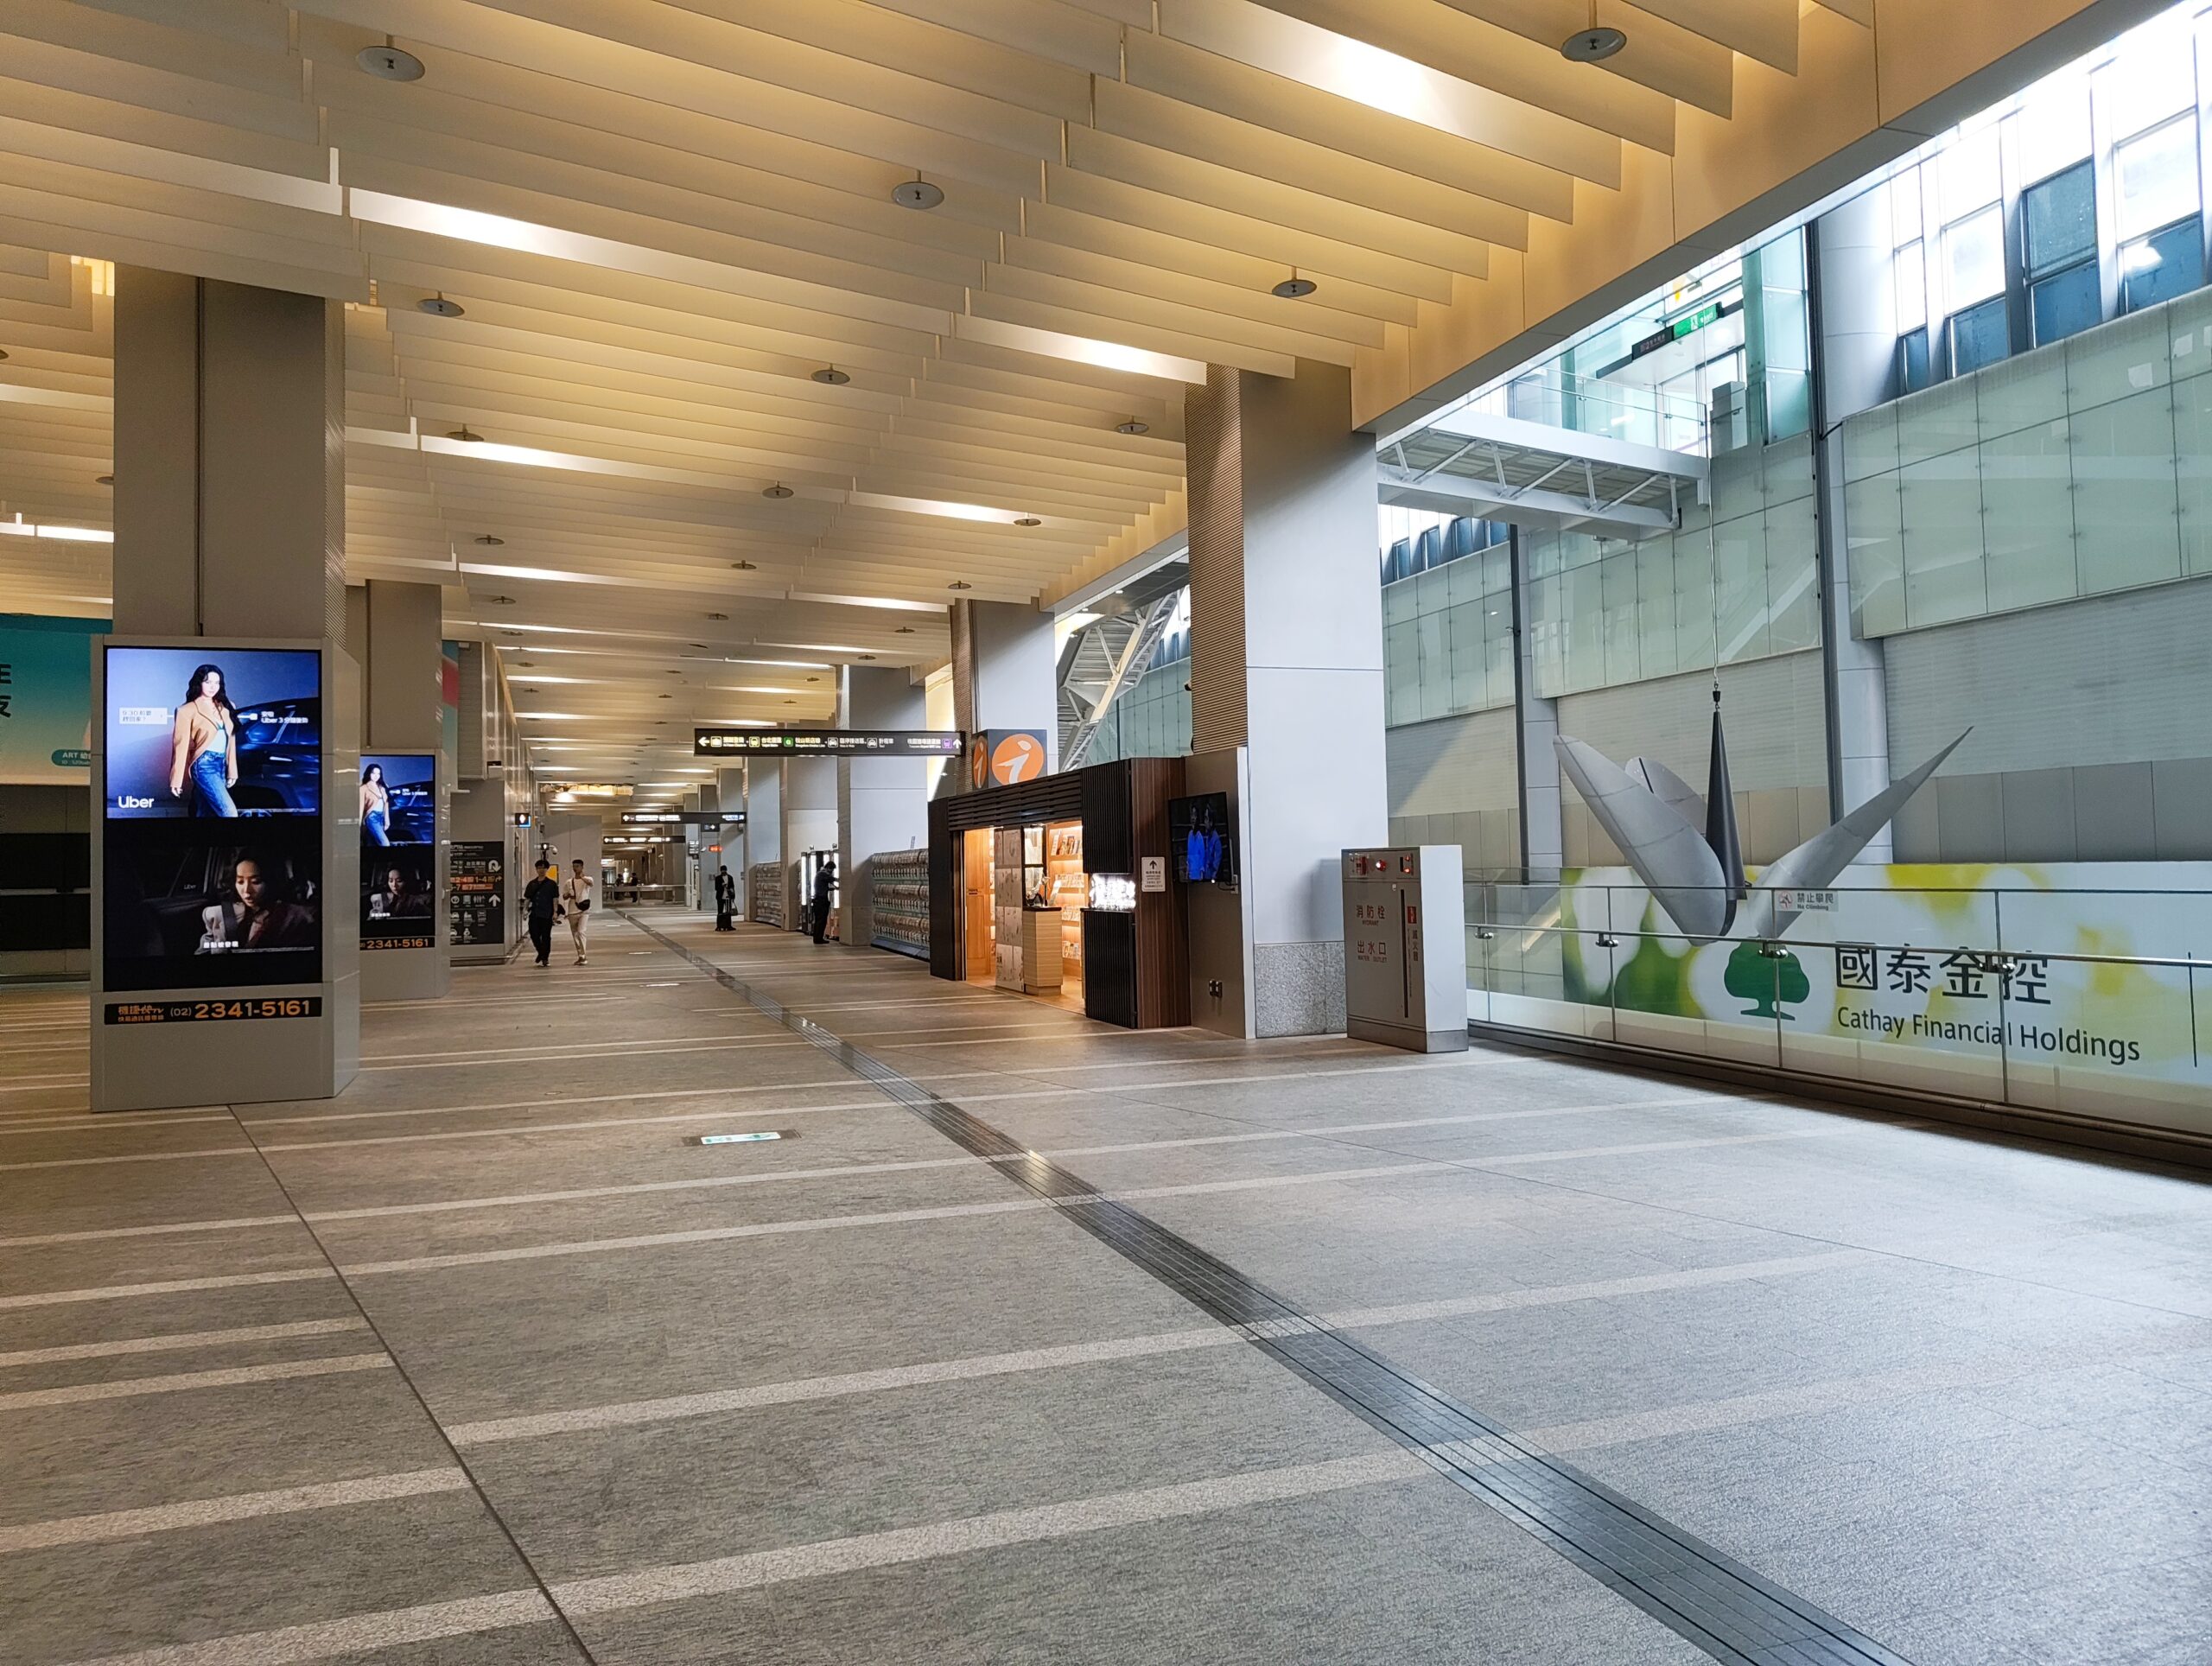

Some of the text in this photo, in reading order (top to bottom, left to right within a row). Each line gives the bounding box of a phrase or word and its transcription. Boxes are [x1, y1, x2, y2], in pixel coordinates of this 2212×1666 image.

[118, 795, 155, 809] Uber
[1356, 904, 1385, 919] 消防栓
[366, 938, 429, 949] 2341-5161
[1357, 940, 1387, 955] 出水口
[1834, 940, 2052, 1006] 國泰金控
[170, 1007, 192, 1017] (02)
[194, 1000, 310, 1019] 2341-5161
[1837, 1006, 2141, 1065] Cathay Financial Holdings
